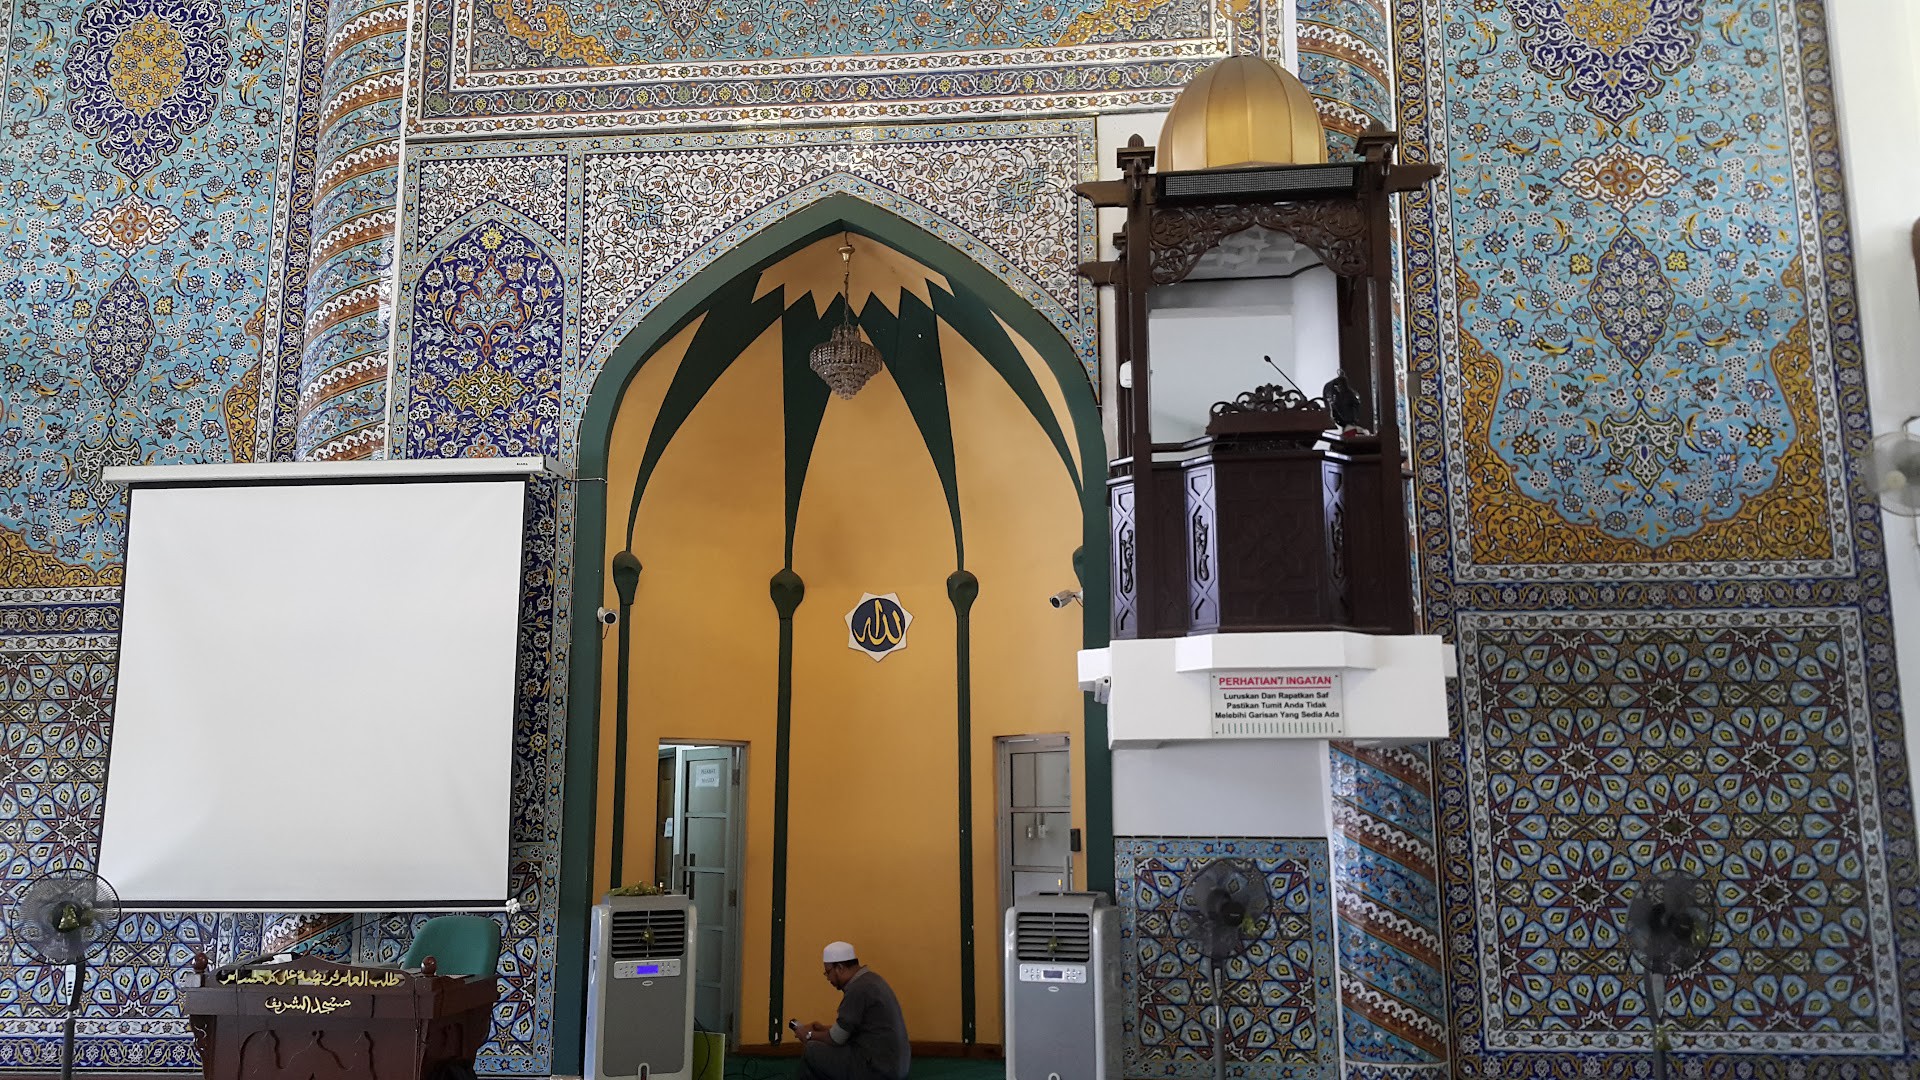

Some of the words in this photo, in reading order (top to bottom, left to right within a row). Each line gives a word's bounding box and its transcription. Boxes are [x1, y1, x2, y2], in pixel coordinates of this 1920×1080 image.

[1286, 676, 1332, 685] INGATAN
[1223, 692, 1260, 700] Luruskan
[1278, 691, 1315, 701] Rapatkan
[1316, 691, 1330, 699] Saf
[1284, 701, 1304, 709] Anda
[1215, 711, 1247, 719] Melebihi
[1280, 711, 1300, 720] Yang
[1301, 710, 1323, 718] Sedia
[1324, 710, 1340, 718] Ada
